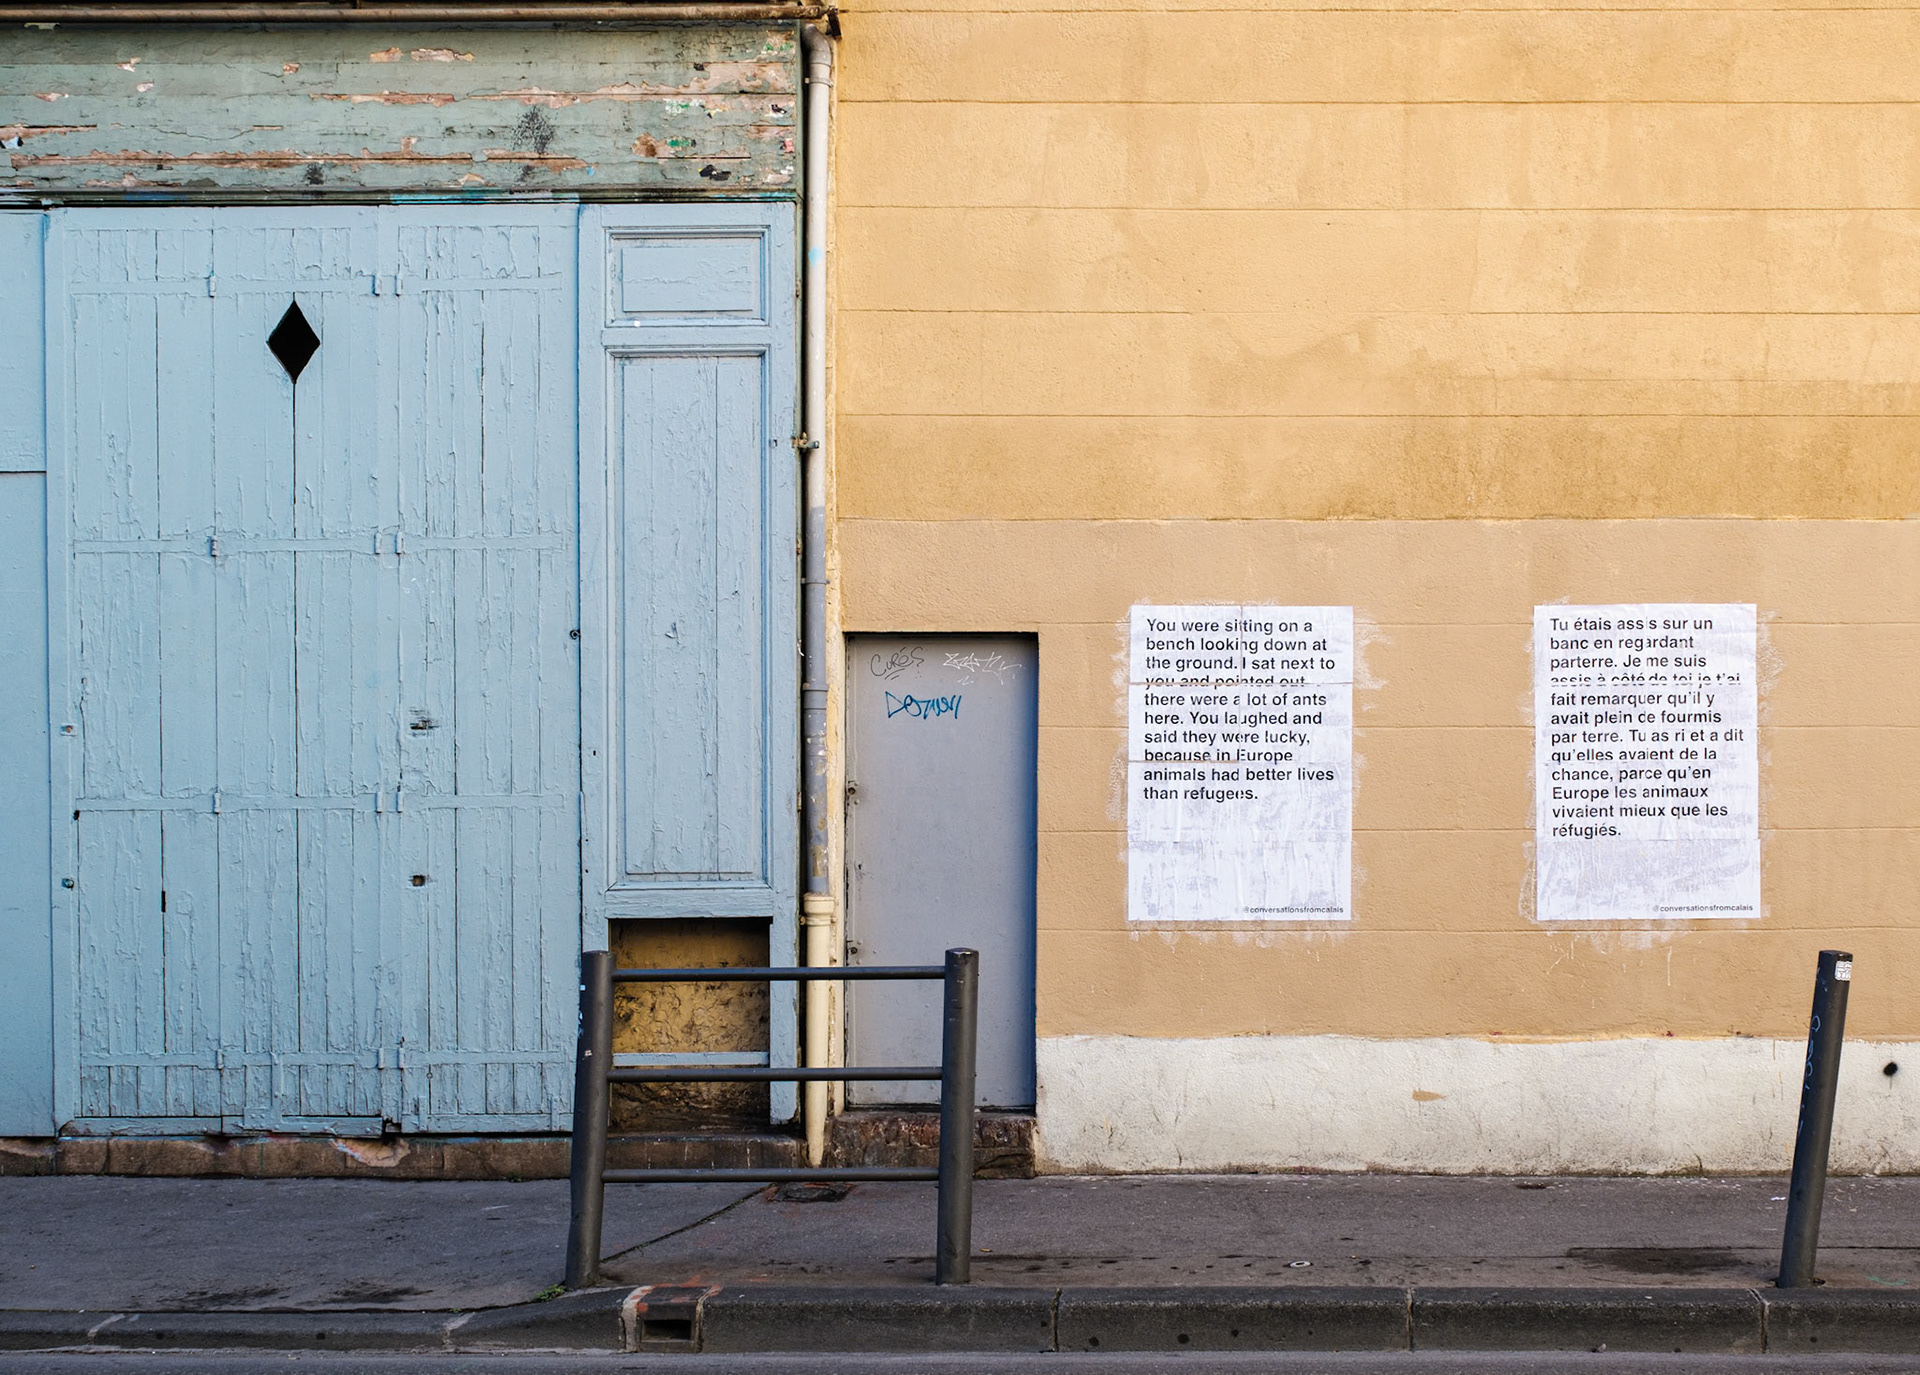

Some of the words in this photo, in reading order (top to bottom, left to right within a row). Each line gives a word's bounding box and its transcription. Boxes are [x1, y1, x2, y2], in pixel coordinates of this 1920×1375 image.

[1146, 618, 1176, 632] You
[1181, 621, 1220, 632] were
[1278, 621, 1299, 633] on
[1303, 621, 1313, 633] a
[1549, 617, 1568, 631] Tu
[1573, 617, 1612, 631] étais
[1662, 619, 1689, 630] sur
[1693, 619, 1713, 630] un
[1146, 636, 1195, 651] bench
[1200, 637, 1259, 654] looking
[1263, 637, 1307, 652] down
[1312, 638, 1328, 652] at
[1550, 637, 1589, 650] banc
[1593, 638, 1613, 650] en
[1145, 655, 1171, 670] the
[1175, 656, 1238, 672] ground.
[1251, 657, 1276, 670] sat
[1280, 657, 1315, 670] next
[1319, 657, 1336, 670] to
[1550, 655, 1618, 672] parterre.
[1622, 654, 1642, 668] Je
[1646, 656, 1669, 668] me
[1674, 653, 1707, 668] suis
[1145, 676, 1175, 690] you
[1179, 674, 1210, 688] and
[1214, 674, 1274, 691] pointed
[1279, 675, 1307, 688] out
[1144, 692, 1186, 706] there
[1190, 695, 1229, 706] were
[1232, 695, 1240, 706] a
[1247, 692, 1268, 706] lot
[1272, 692, 1288, 706] of
[1292, 693, 1327, 706] ants
[1550, 692, 1576, 706] fait
[1580, 693, 1663, 709] remarquer
[1705, 693, 1716, 708] y
[1144, 711, 1184, 725] here.
[1189, 711, 1219, 725] You
[1292, 711, 1322, 725] and
[1550, 711, 1590, 725] avait
[1594, 710, 1633, 728] plein
[1637, 711, 1656, 724] de
[1660, 709, 1722, 724] fourmis
[1144, 729, 1178, 744] said
[1182, 729, 1217, 747] they
[1221, 732, 1260, 744] were
[1264, 730, 1310, 747] lucky,
[1551, 731, 1577, 746] par
[1581, 730, 1623, 743] terre.
[1628, 729, 1646, 743] Tu
[1651, 731, 1670, 743] as
[1674, 728, 1685, 742] ri
[1690, 729, 1705, 742] et
[1709, 731, 1719, 742] a
[1723, 728, 1744, 742] dit
[1144, 748, 1212, 763] because
[1216, 748, 1231, 764] in
[1236, 748, 1293, 766] Europe
[1618, 747, 1675, 760] avaient
[1679, 747, 1699, 760] de
[1704, 747, 1717, 760] la
[1143, 767, 1206, 782] animals
[1211, 767, 1240, 782] had
[1245, 767, 1293, 781] better
[1297, 767, 1335, 781] lives
[1551, 766, 1614, 783] chance,
[1618, 768, 1663, 784] parce
[1142, 786, 1179, 800] than
[1183, 786, 1258, 804] refugees.
[1552, 786, 1610, 803] Europe
[1614, 785, 1637, 799] les
[1642, 784, 1709, 799] animaux
[1552, 804, 1615, 819] vivaient
[1619, 803, 1666, 817] mieux
[1670, 805, 1701, 820] que
[1705, 803, 1729, 817] les
[1552, 822, 1621, 840] réfugiés.
